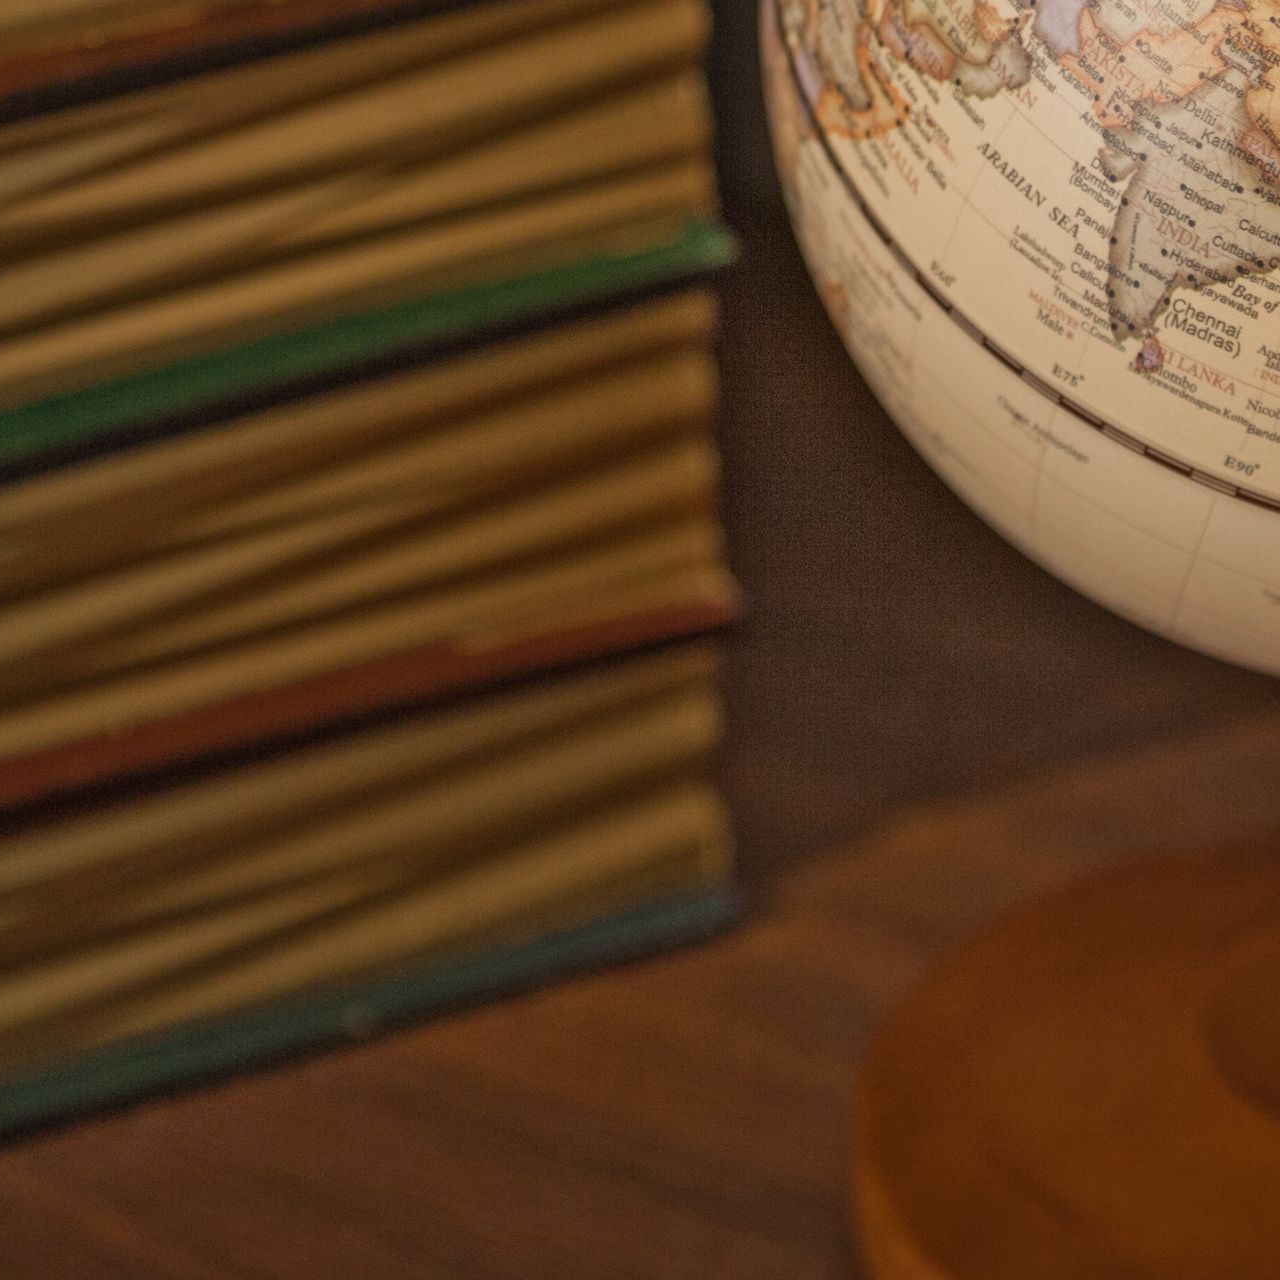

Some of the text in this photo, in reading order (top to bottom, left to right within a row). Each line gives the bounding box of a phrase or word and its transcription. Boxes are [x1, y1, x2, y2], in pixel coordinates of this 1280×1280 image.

[1058, 68, 1097, 99] Karachi
[1077, 54, 1098, 79] Bela
[1155, 79, 1218, 128] New Delhi
[1165, 122, 1196, 147] Jaipur
[1200, 128, 1280, 178] Kathmandu
[977, 142, 1047, 208] ARABIAN
[1048, 207, 1081, 239] SEA
[1178, 153, 1238, 192] Allahabad
[1143, 190, 1191, 226] Nagpur
[1183, 186, 1226, 215] Bhopal
[1075, 208, 1110, 239] Panaji
[1156, 218, 1211, 258] INDIA
[1211, 236, 1257, 265] Cuttack
[1053, 286, 1110, 328] Trivandrum
[1171, 298, 1242, 339] Chennai
[1232, 284, 1257, 306] Bay
[1262, 299, 1280, 314] of
[1164, 312, 1241, 358] (Madras)
[1147, 344, 1236, 397] SRI LANKA
